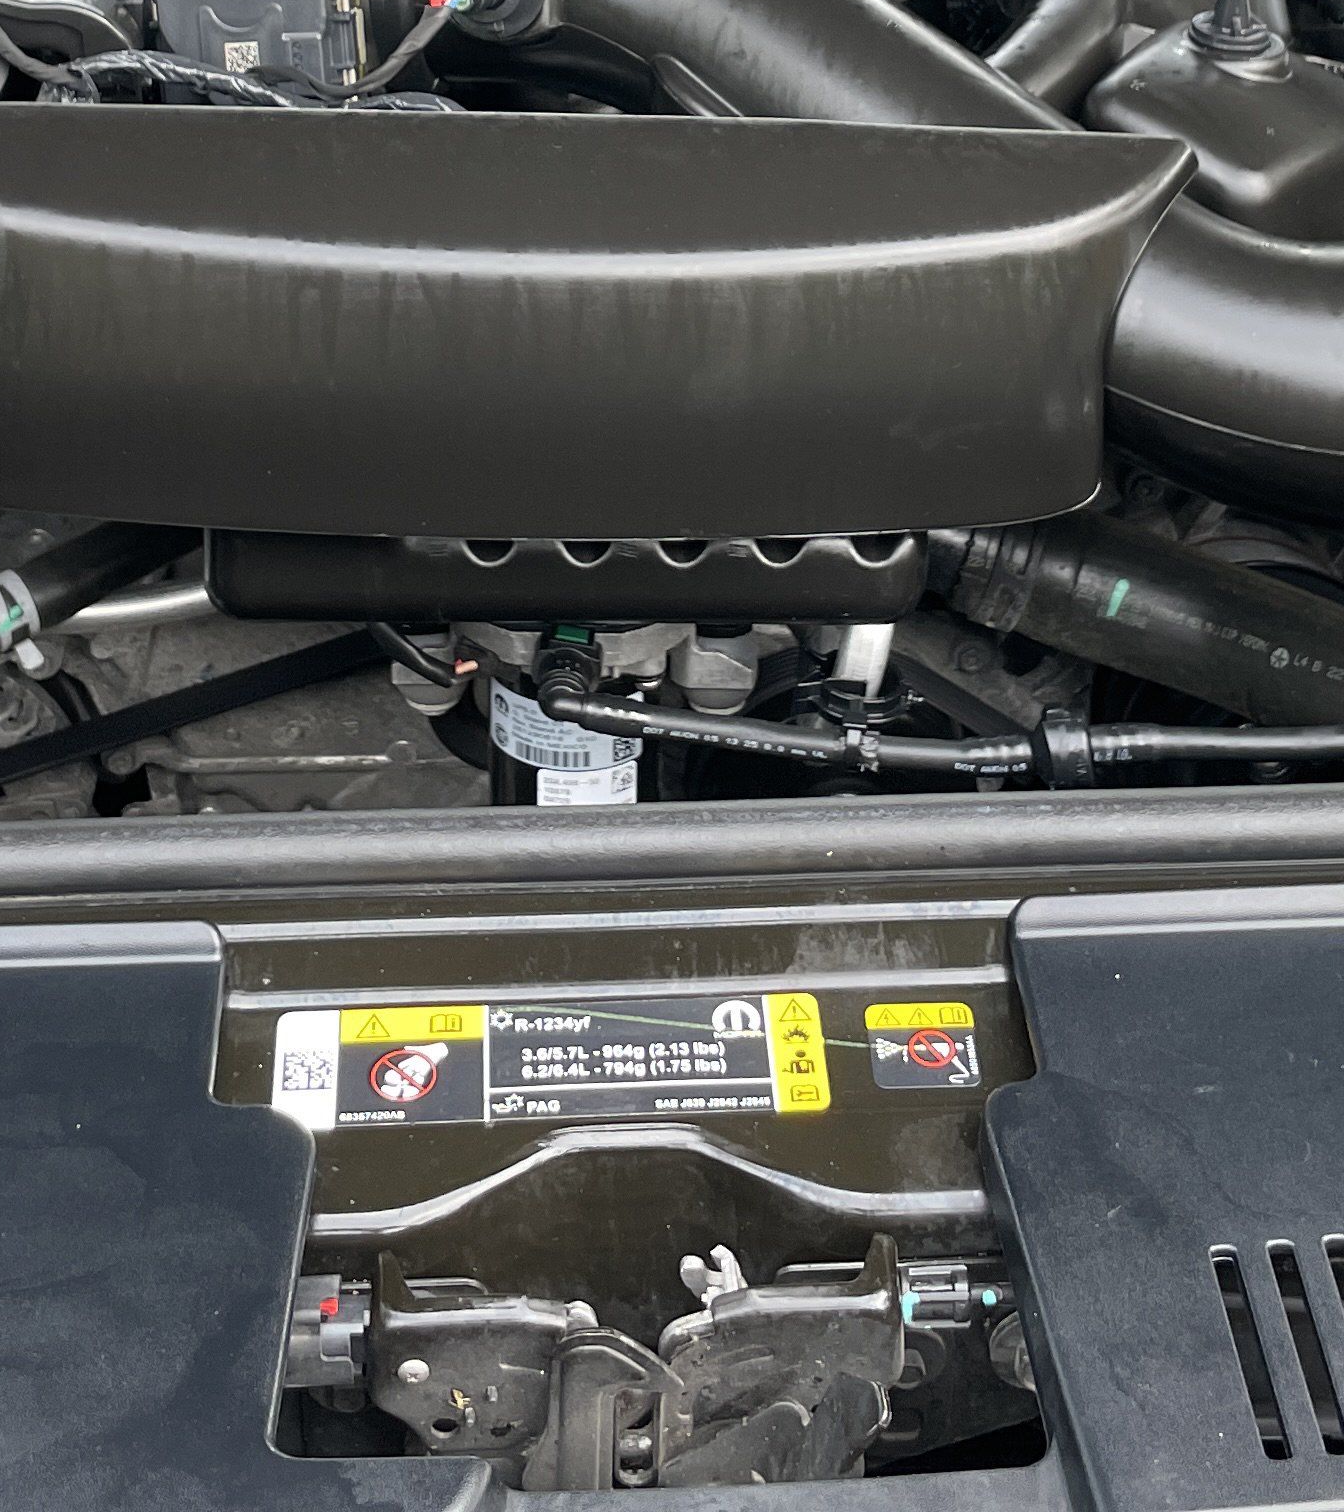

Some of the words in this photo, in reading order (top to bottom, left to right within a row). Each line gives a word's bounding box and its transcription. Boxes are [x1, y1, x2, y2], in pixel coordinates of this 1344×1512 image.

[513, 1014, 592, 1034] R-1234yf
[521, 1044, 590, 1062] 3.6/5.7L
[602, 1044, 645, 1061] 964g
[649, 1041, 690, 1059] (2.13
[692, 1040, 726, 1058] lbs)
[521, 1062, 591, 1080] 6.2/6.4L
[603, 1060, 646, 1077] 794g
[649, 1058, 692, 1076] (1.75
[694, 1057, 728, 1075] lbs)
[526, 1099, 561, 1114] PAG
